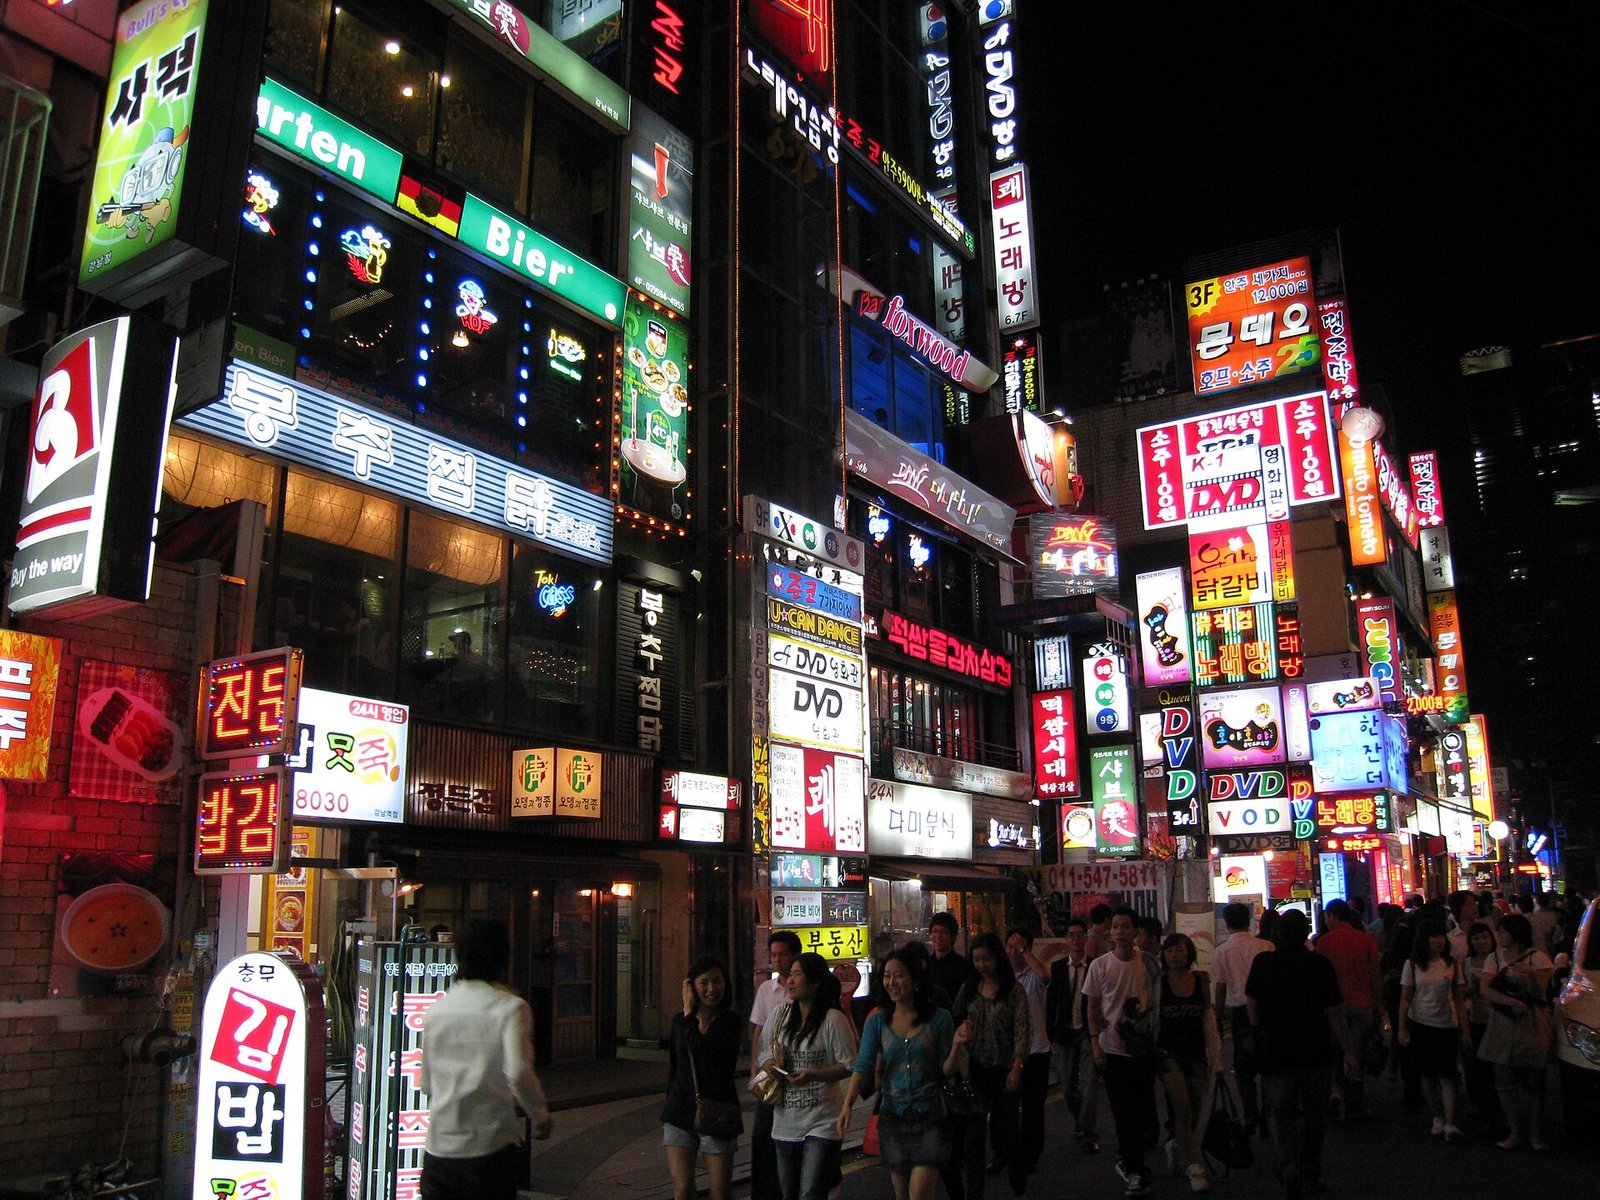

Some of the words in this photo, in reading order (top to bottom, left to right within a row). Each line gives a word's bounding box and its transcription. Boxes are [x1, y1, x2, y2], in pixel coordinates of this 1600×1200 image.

[108, 26, 200, 132] 사격
[486, 215, 567, 287] Bier
[999, 217, 1028, 307] 노래방
[1190, 283, 1214, 308] 3F
[1223, 275, 1248, 293] 안주
[1004, 312, 1028, 326] 6.7F
[882, 295, 970, 383] foxwood
[1277, 336, 1321, 377] 25
[1293, 400, 1318, 440] 소주
[228, 367, 555, 540] 봉추찜닭
[1151, 430, 1171, 467] 소주
[1191, 453, 1224, 472] K-1
[1300, 445, 1326, 497] 100원
[1157, 472, 1178, 522] 100원
[1190, 477, 1261, 513] DVD
[1356, 494, 1378, 556] tomato
[11, 566, 27, 588] Buy
[28, 560, 47, 581] the
[51, 552, 83, 578] way
[818, 617, 860, 649] DANCE
[1278, 616, 1303, 677] 노래방
[638, 588, 664, 752] 봉추찜닭
[1197, 640, 1271, 678] 노래방
[351, 702, 380, 717] 24시
[381, 704, 405, 722] 영업
[793, 680, 843, 719] DVD
[1158, 690, 1191, 706] Queen
[1162, 706, 1196, 801] DVD
[869, 782, 895, 802] 24시
[1210, 770, 1285, 800] DVD
[888, 808, 955, 839] 다미분식
[1291, 780, 1315, 840] DVD
[1317, 797, 1374, 826] 노래방
[787, 904, 806, 918] 가르텐
[807, 928, 863, 958] 부동산
[238, 961, 275, 983] 충무
[217, 989, 290, 1156] 김밥
